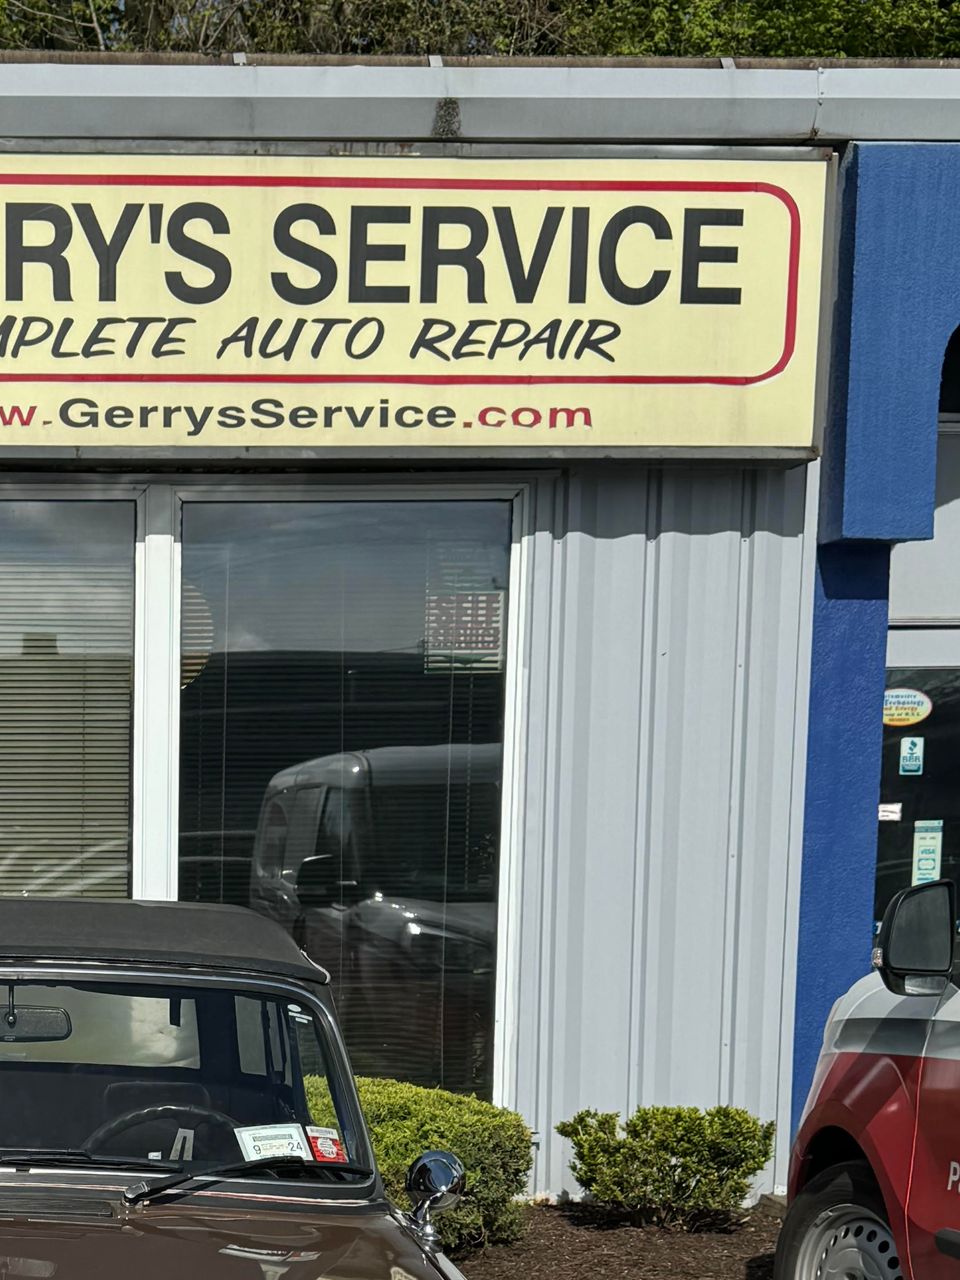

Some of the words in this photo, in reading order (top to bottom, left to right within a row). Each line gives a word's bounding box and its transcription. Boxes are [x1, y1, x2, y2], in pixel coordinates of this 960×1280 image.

[270, 202, 744, 306] SERVICE
[216, 316, 385, 362] AUTO
[409, 318, 622, 363] REPAIR
[252, 1144, 262, 1155] 9
[288, 1141, 303, 1152] 24
